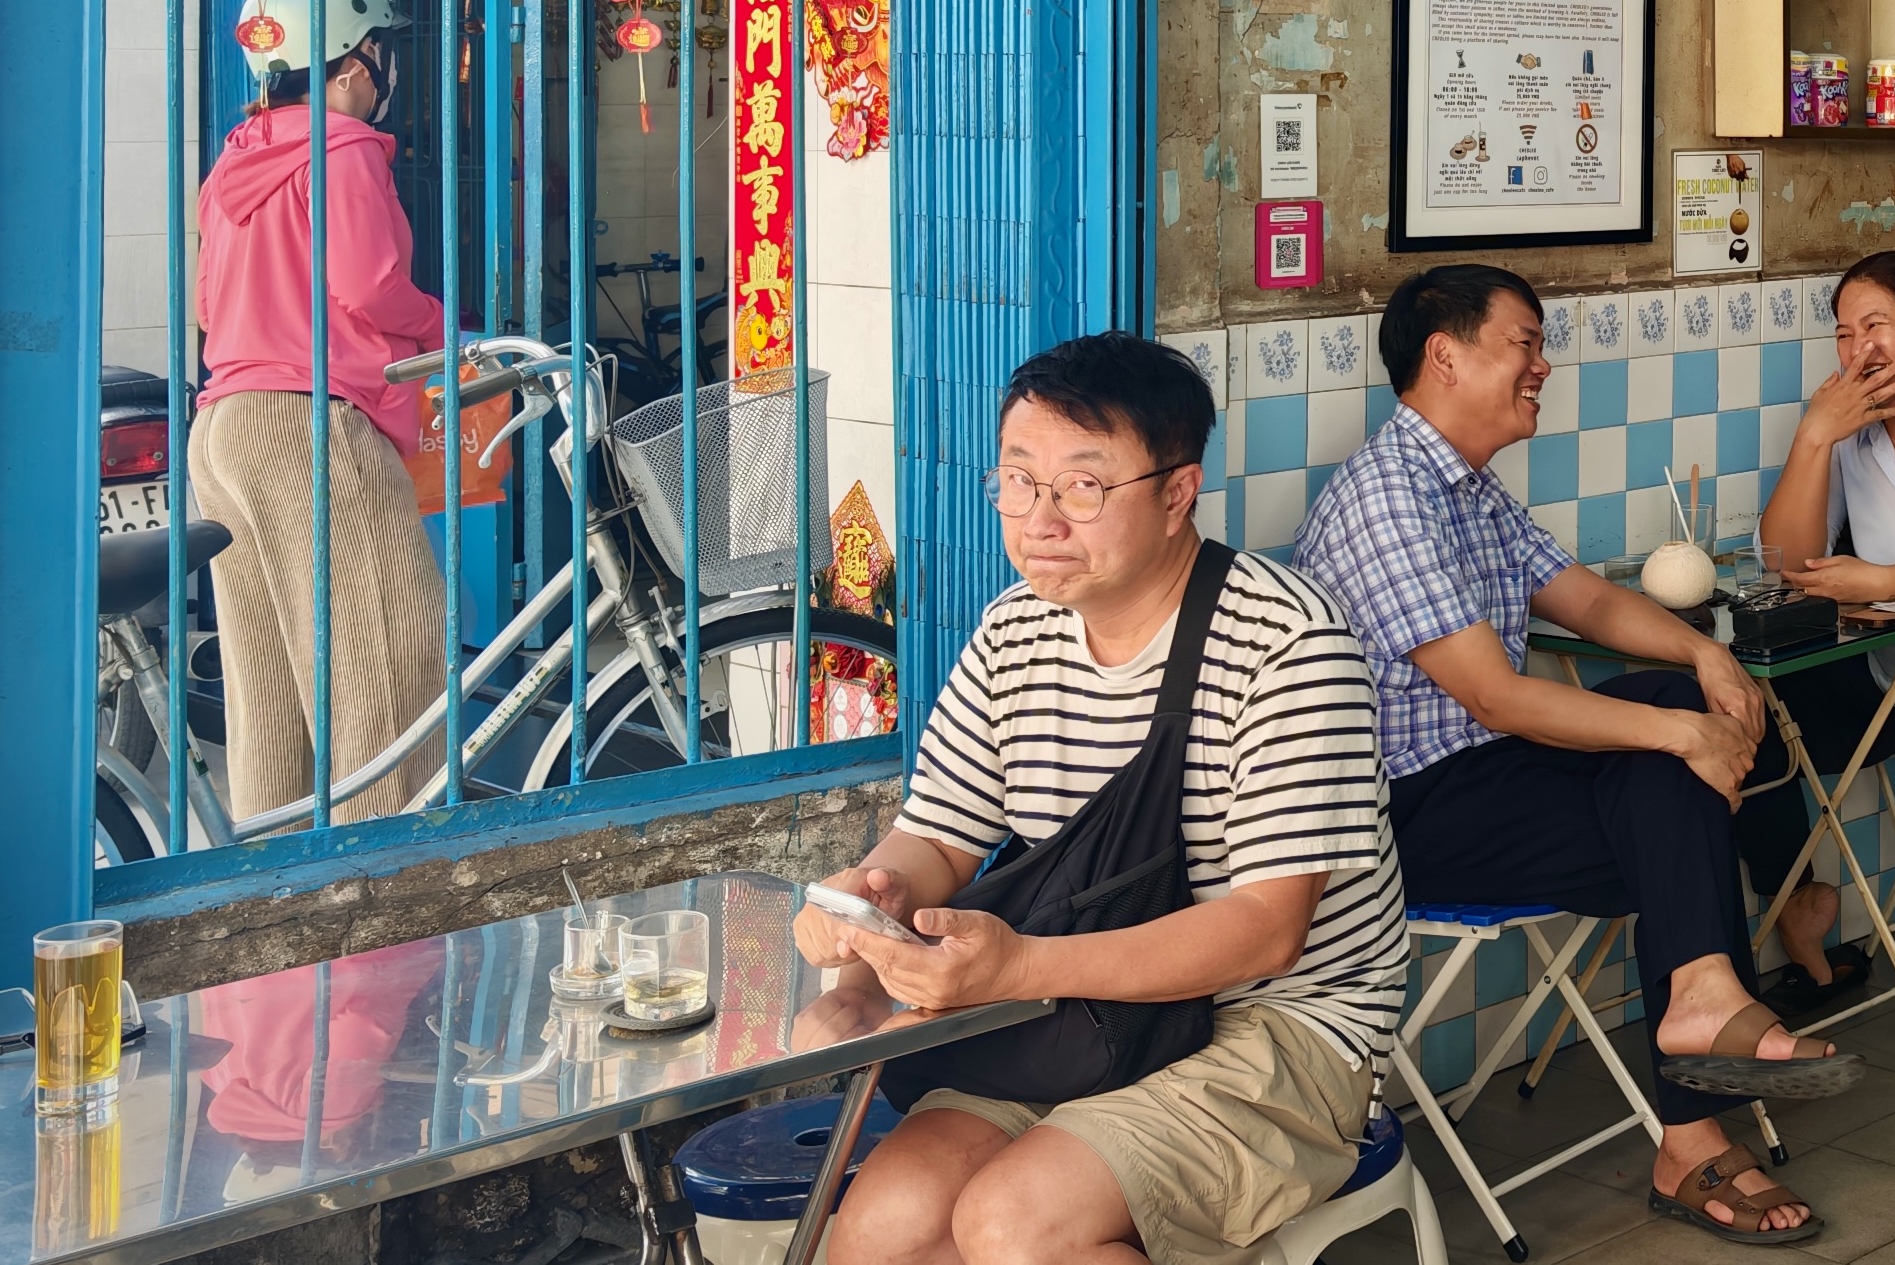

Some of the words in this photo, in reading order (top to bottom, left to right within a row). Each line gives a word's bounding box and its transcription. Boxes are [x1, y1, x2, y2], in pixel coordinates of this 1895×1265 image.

[1677, 179, 1700, 196] FRESH
[1702, 178, 1734, 195] COCONUT
[1736, 177, 1759, 193] WATER
[1681, 209, 1695, 217] NƯỚC
